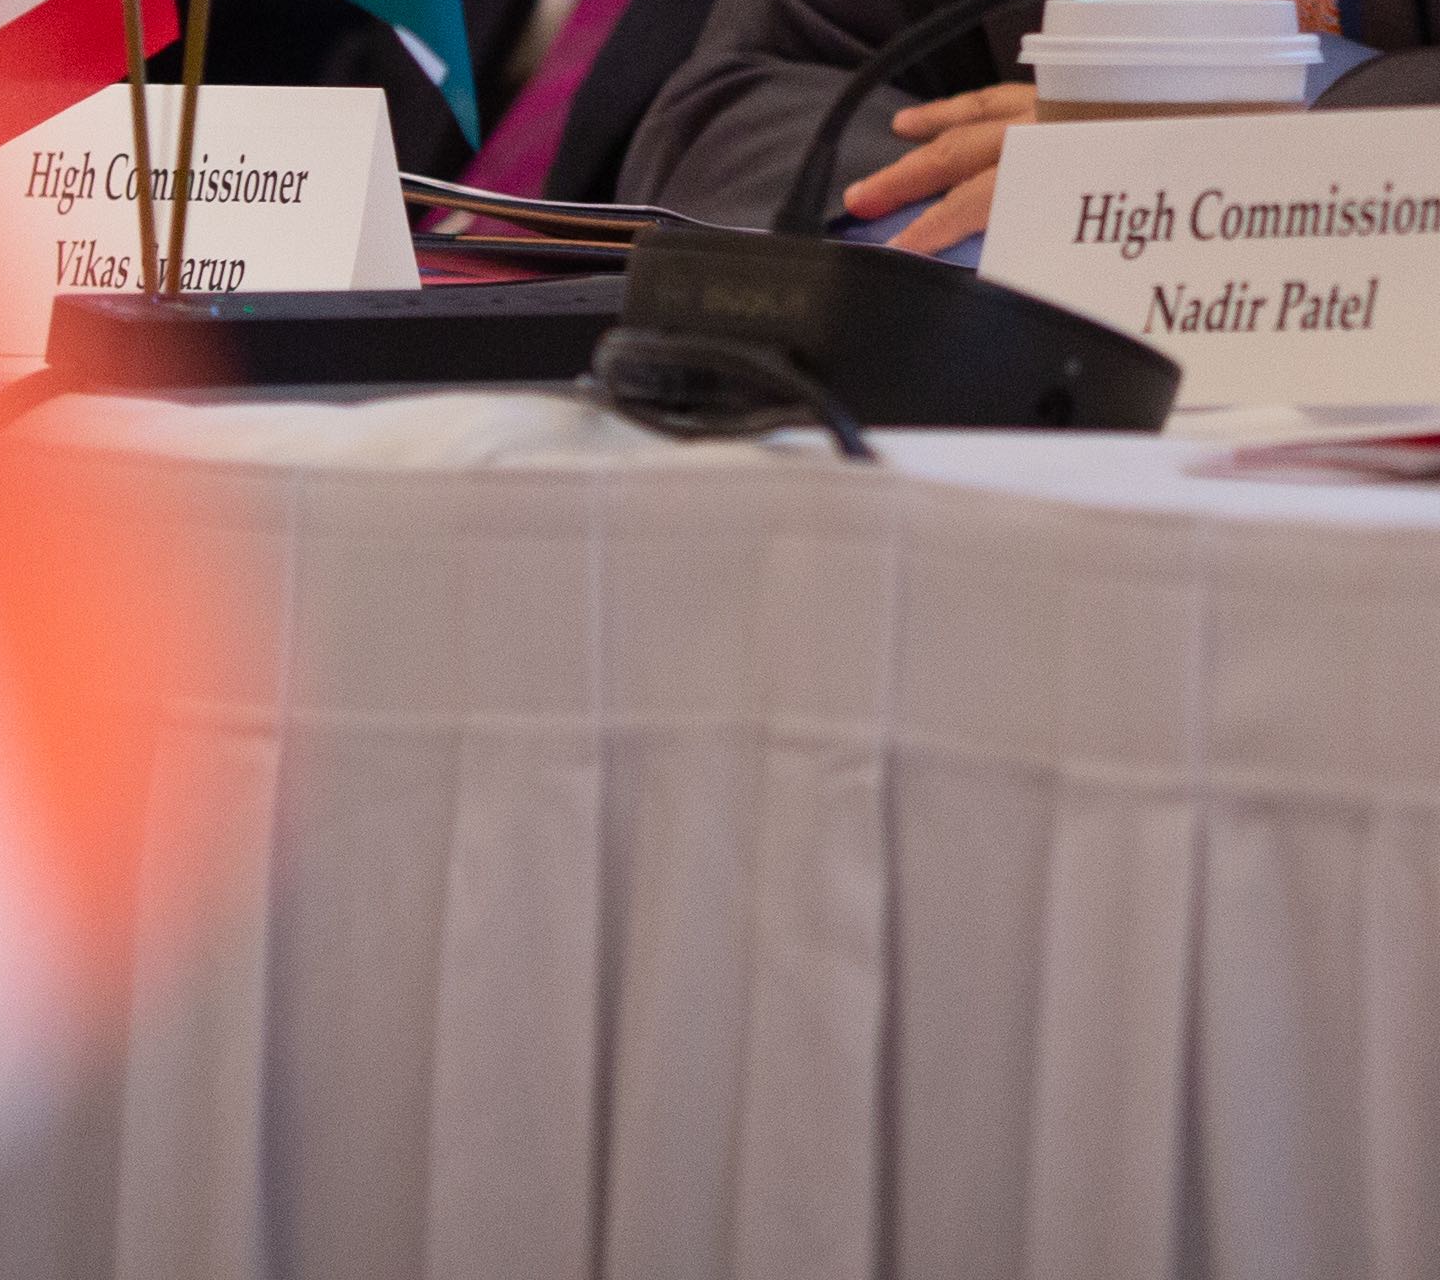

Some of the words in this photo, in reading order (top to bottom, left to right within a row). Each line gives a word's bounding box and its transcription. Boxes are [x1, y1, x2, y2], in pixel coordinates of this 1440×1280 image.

[25, 151, 96, 216] High
[1073, 191, 1176, 259] High
[54, 240, 131, 290] Vikas
[136, 242, 246, 294] arup
[1142, 281, 1267, 337] Nadir
[1274, 278, 1380, 334] Patel
